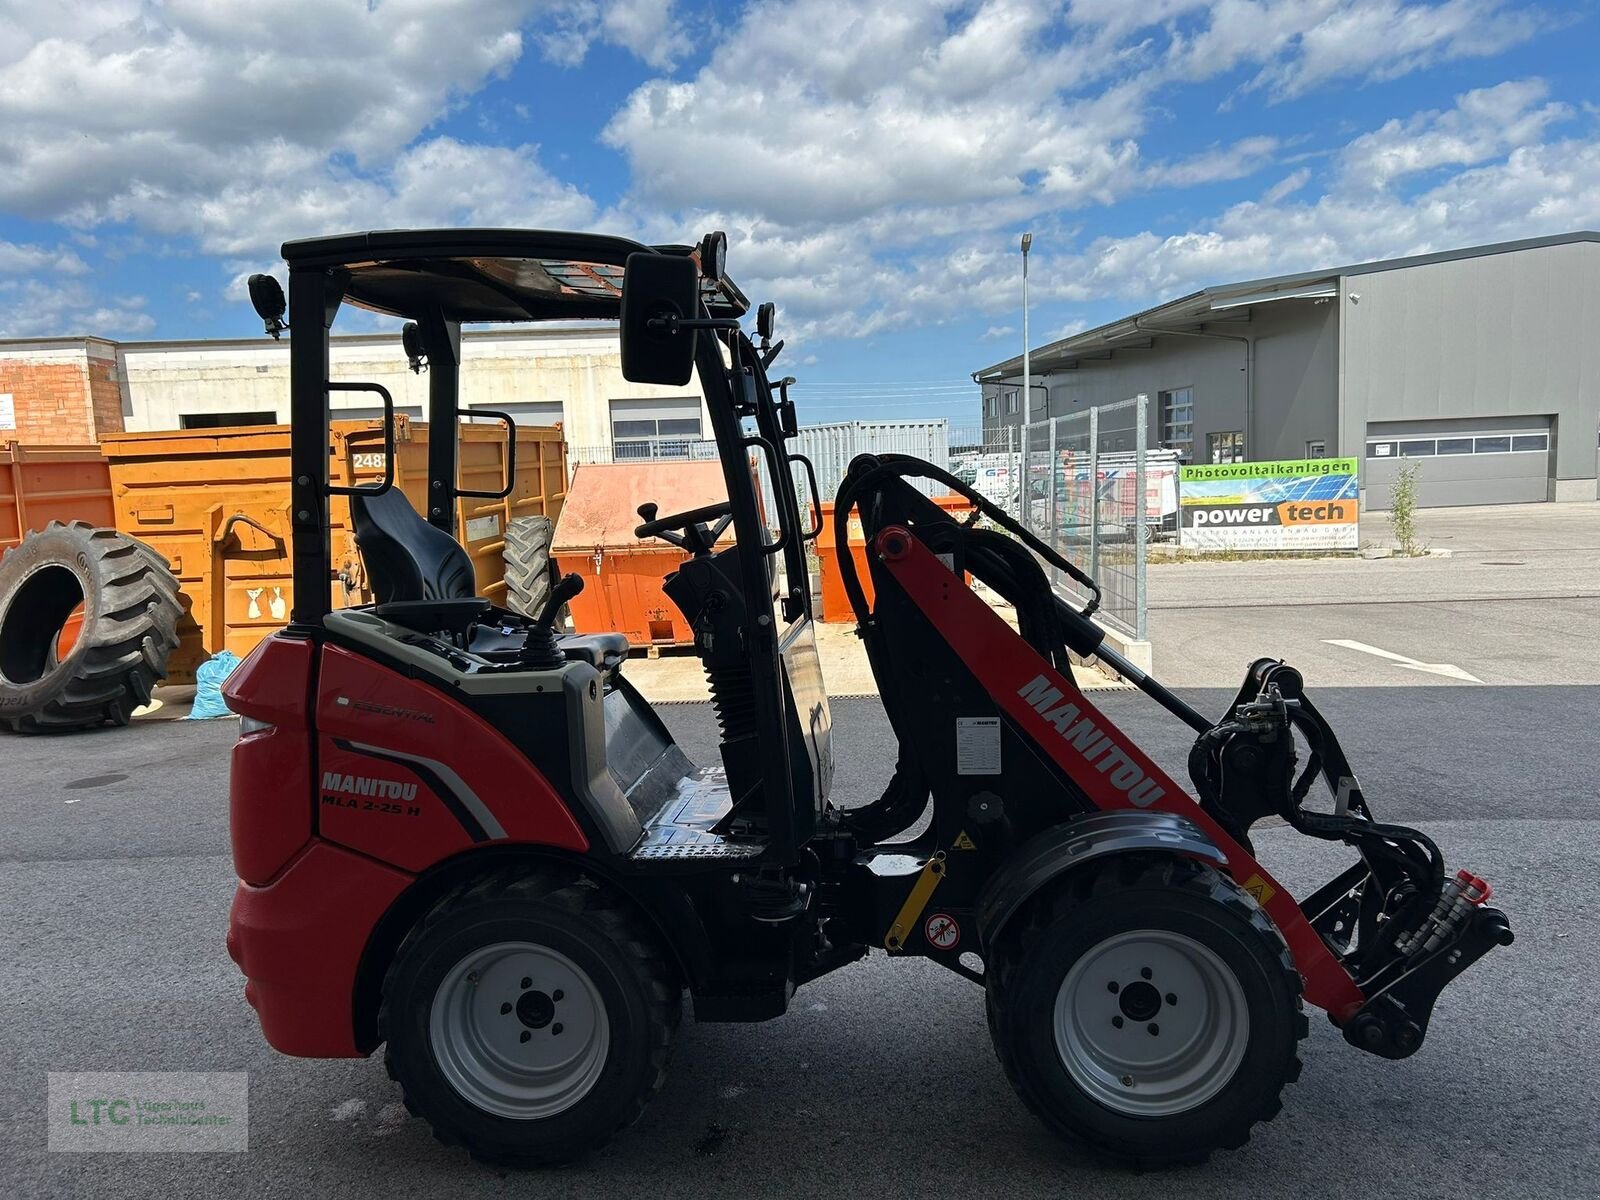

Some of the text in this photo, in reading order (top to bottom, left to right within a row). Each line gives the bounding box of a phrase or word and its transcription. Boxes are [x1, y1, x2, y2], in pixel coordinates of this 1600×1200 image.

[354, 454, 386, 468] 248
[1186, 462, 1351, 478] Photovoltaikanlagen
[1193, 503, 1344, 528] power tech
[1017, 674, 1166, 807] MANITOU
[322, 772, 417, 801] MANITOU
[321, 795, 421, 816] MLA 2-25 H
